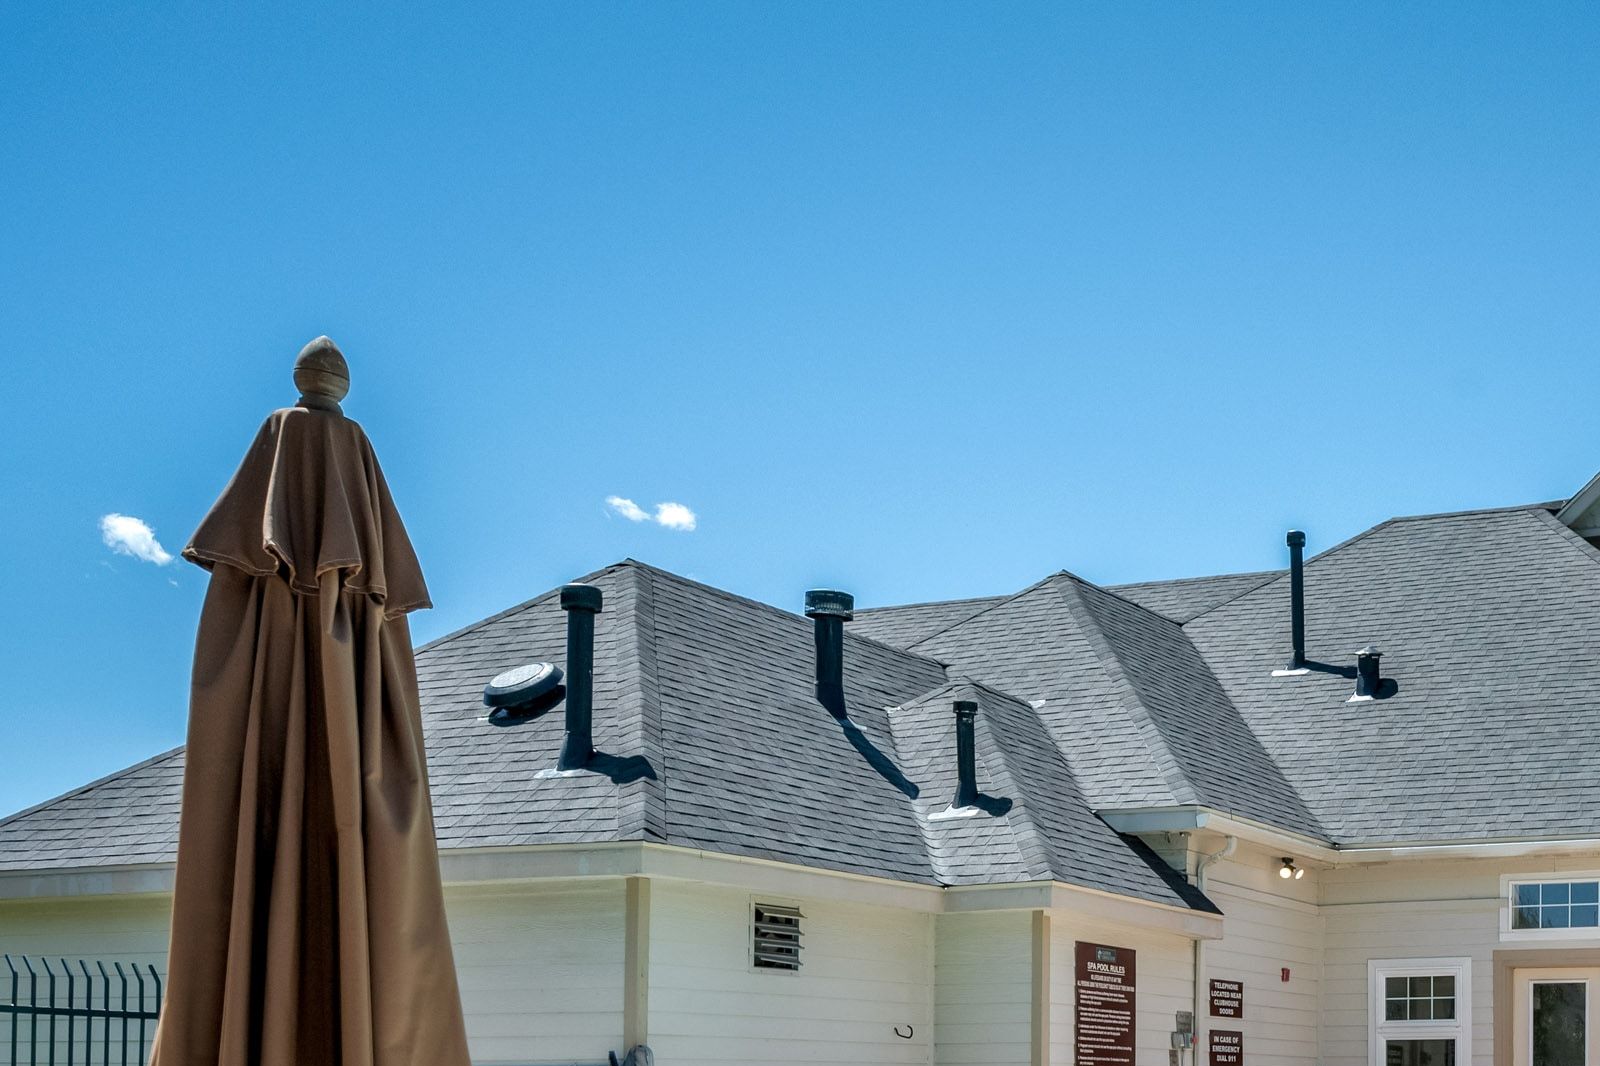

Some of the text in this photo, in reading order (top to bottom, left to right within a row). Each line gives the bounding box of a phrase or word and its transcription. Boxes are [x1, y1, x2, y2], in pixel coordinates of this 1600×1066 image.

[1087, 961, 1125, 973] SPA POOL RULES
[1214, 982, 1239, 990] TELEPHONE
[1211, 990, 1230, 998] LOCATED
[1213, 999, 1239, 1007] CLUBHOUSE
[1220, 1036, 1232, 1044] CASE
[1212, 1045, 1240, 1053] EMERGENCY
